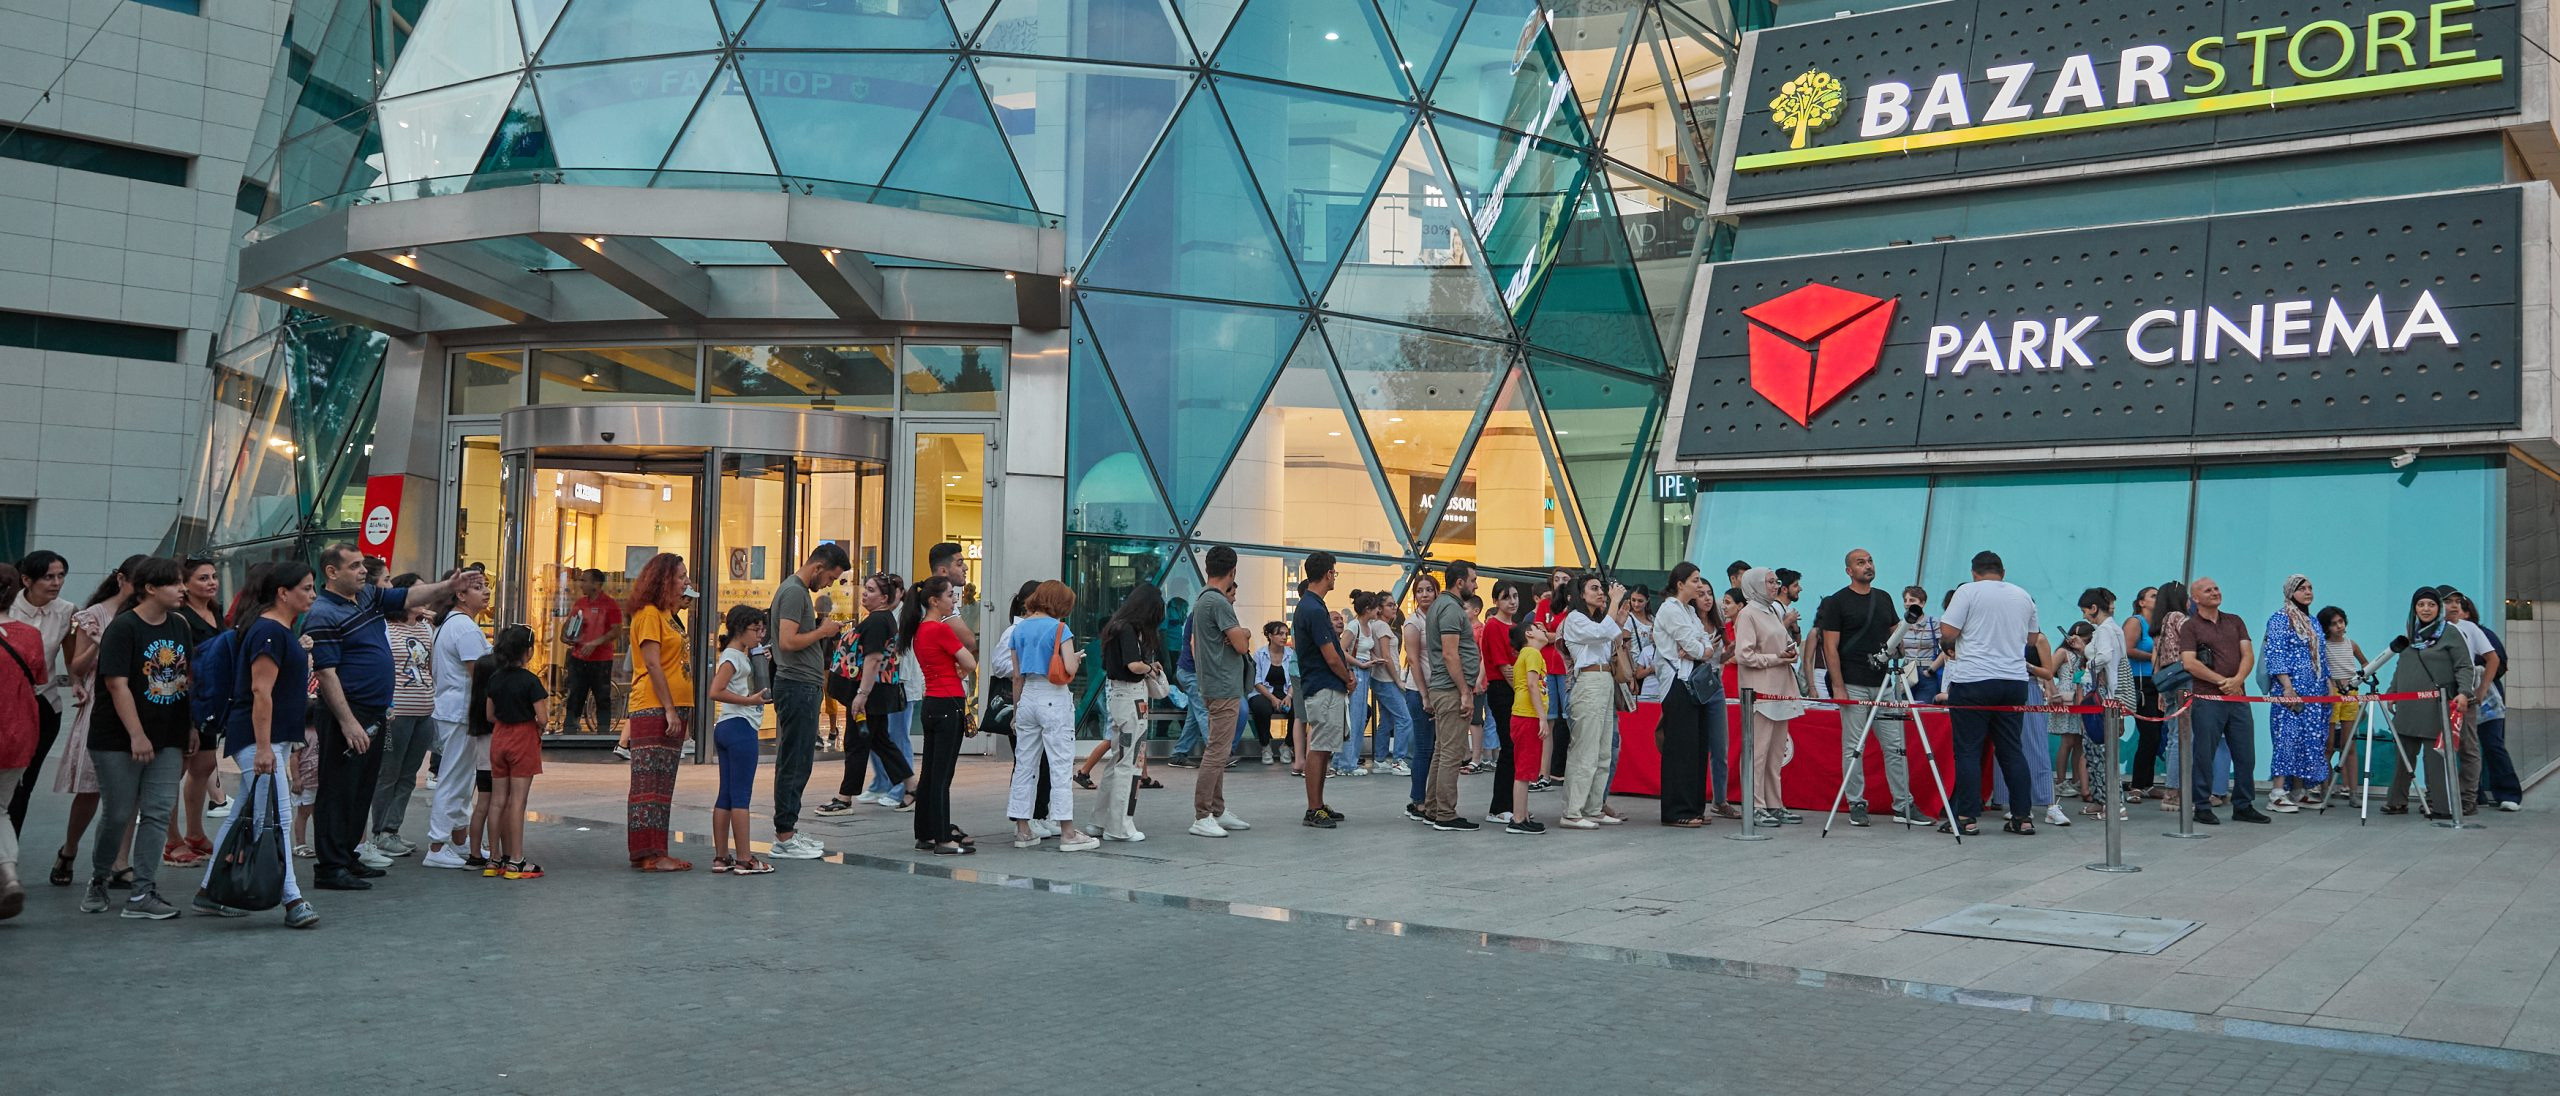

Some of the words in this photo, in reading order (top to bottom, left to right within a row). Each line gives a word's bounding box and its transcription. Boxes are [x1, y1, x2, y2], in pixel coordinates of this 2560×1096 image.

[1925, 315, 2099, 378] PARK
[2125, 289, 2459, 366] CINEMA
[143, 639, 175, 659] EMPIRE
